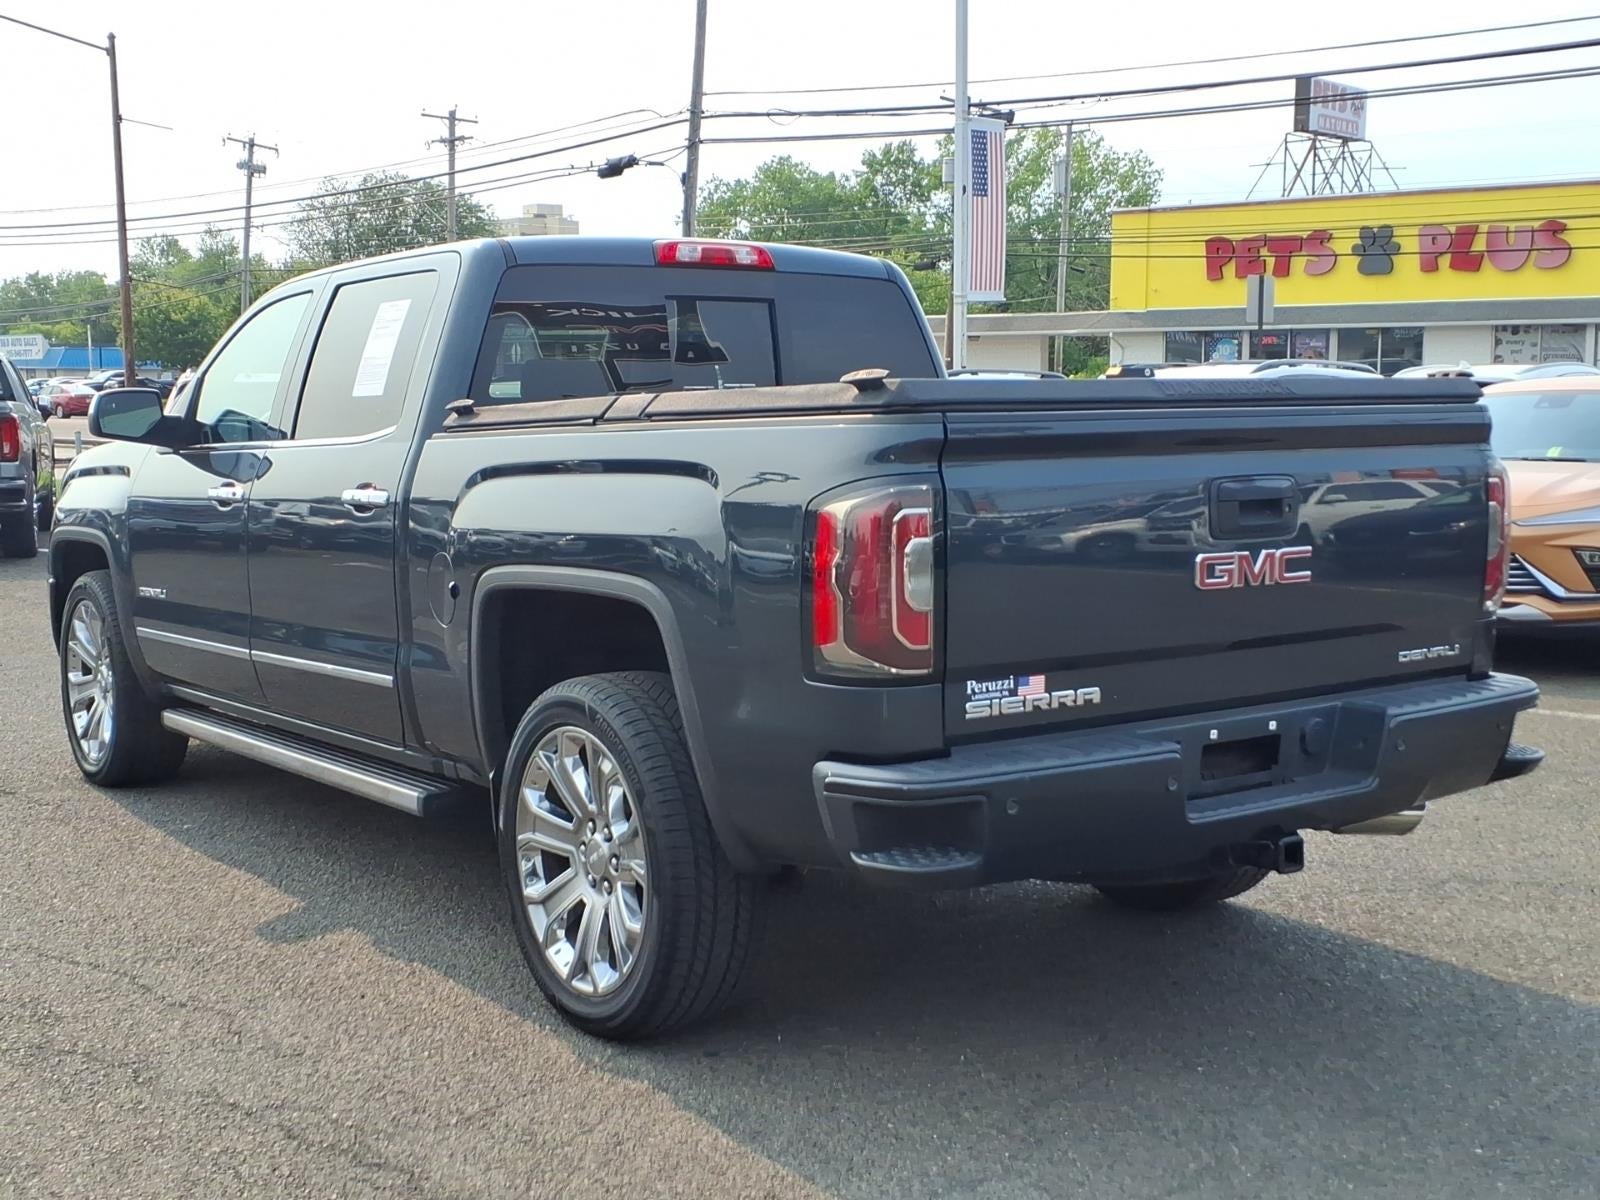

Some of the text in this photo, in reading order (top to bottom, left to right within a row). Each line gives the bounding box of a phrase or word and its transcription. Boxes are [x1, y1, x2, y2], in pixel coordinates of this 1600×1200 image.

[1205, 219, 1572, 281] PETS PLUS
[1195, 546, 1312, 590] GMC
[1398, 643, 1460, 662] DENALI
[966, 674, 1015, 694] Peruzzi
[965, 686, 1102, 720] SIERRA
